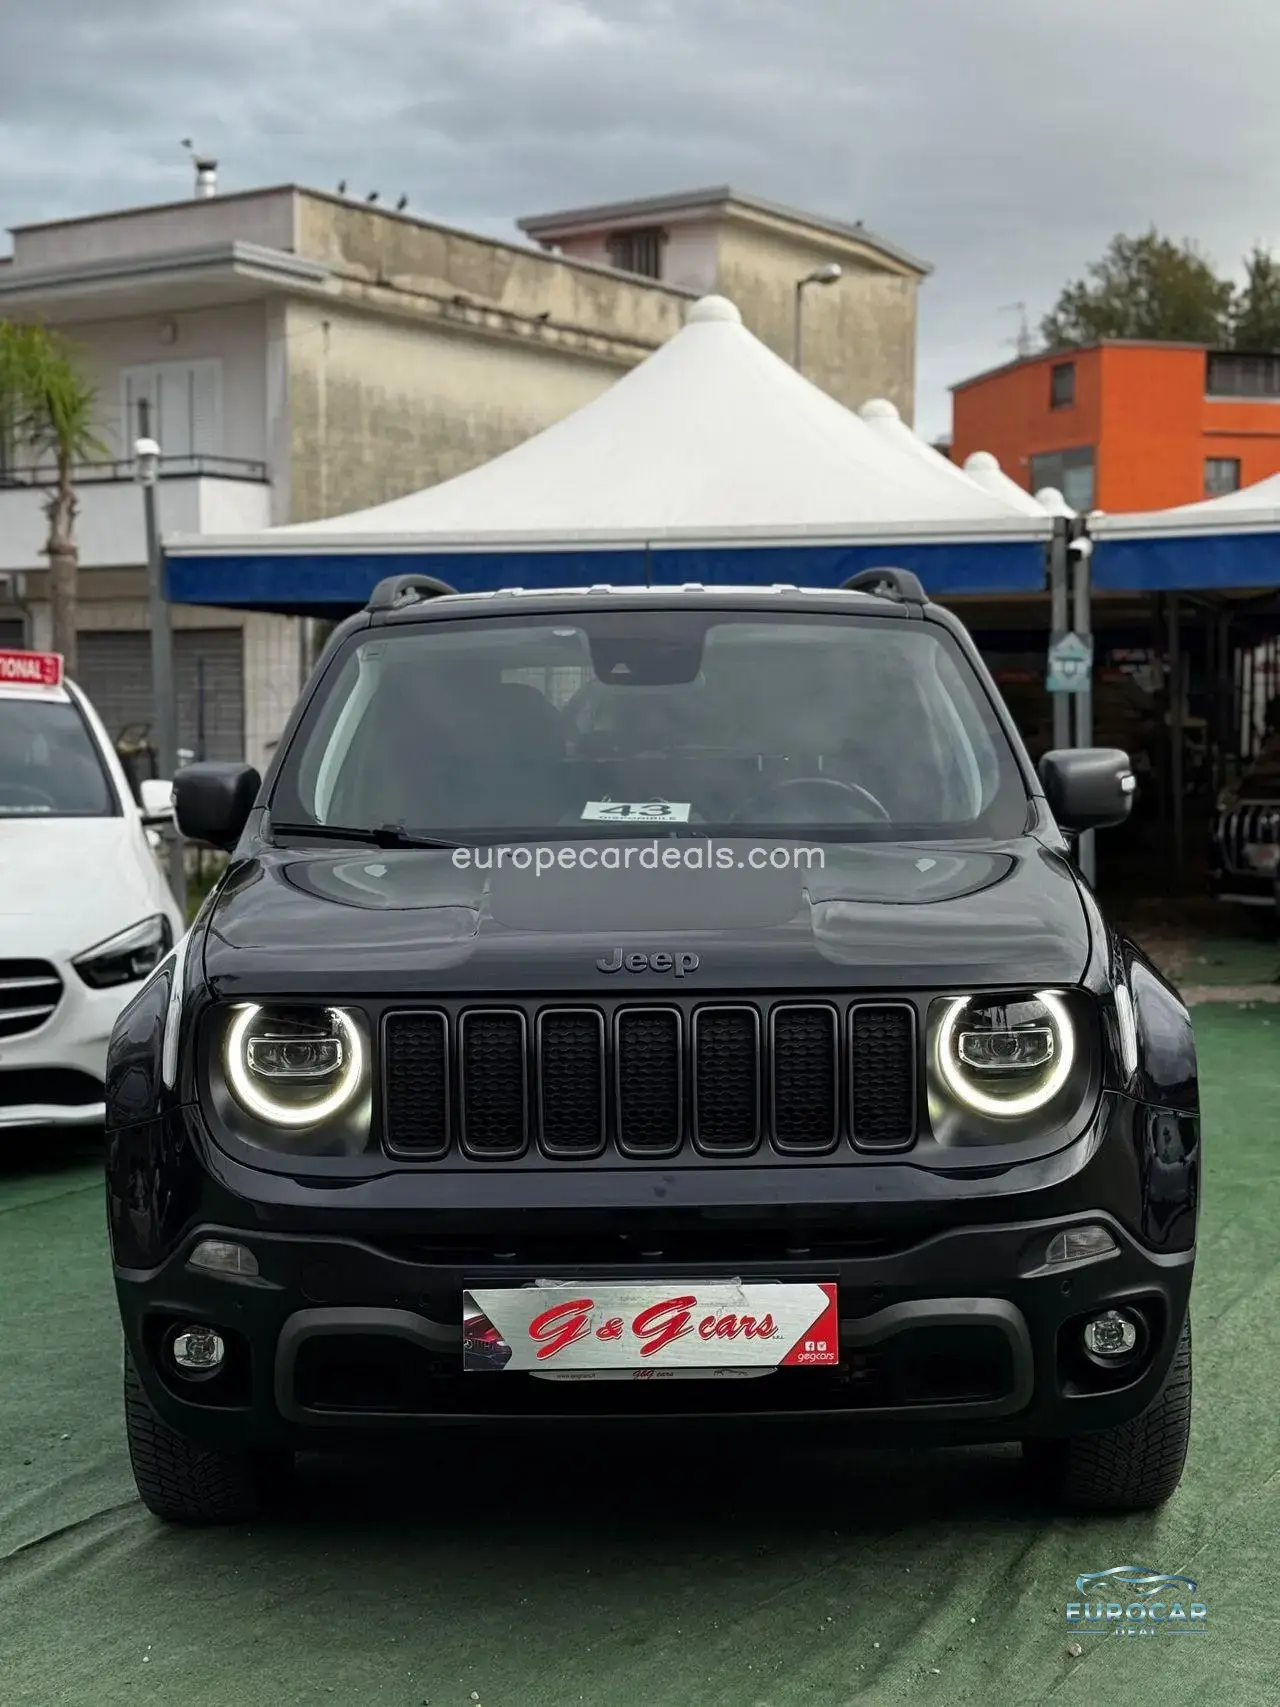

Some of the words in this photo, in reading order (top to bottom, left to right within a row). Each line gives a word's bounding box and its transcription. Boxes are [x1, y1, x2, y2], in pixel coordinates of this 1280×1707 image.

[600, 804, 672, 817] 43
[596, 948, 700, 977] Jeep
[528, 1299, 594, 1360] G
[596, 1317, 624, 1340] &
[631, 1296, 697, 1357] G
[698, 1314, 778, 1341] cars
[797, 1351, 835, 1363] gegcars
